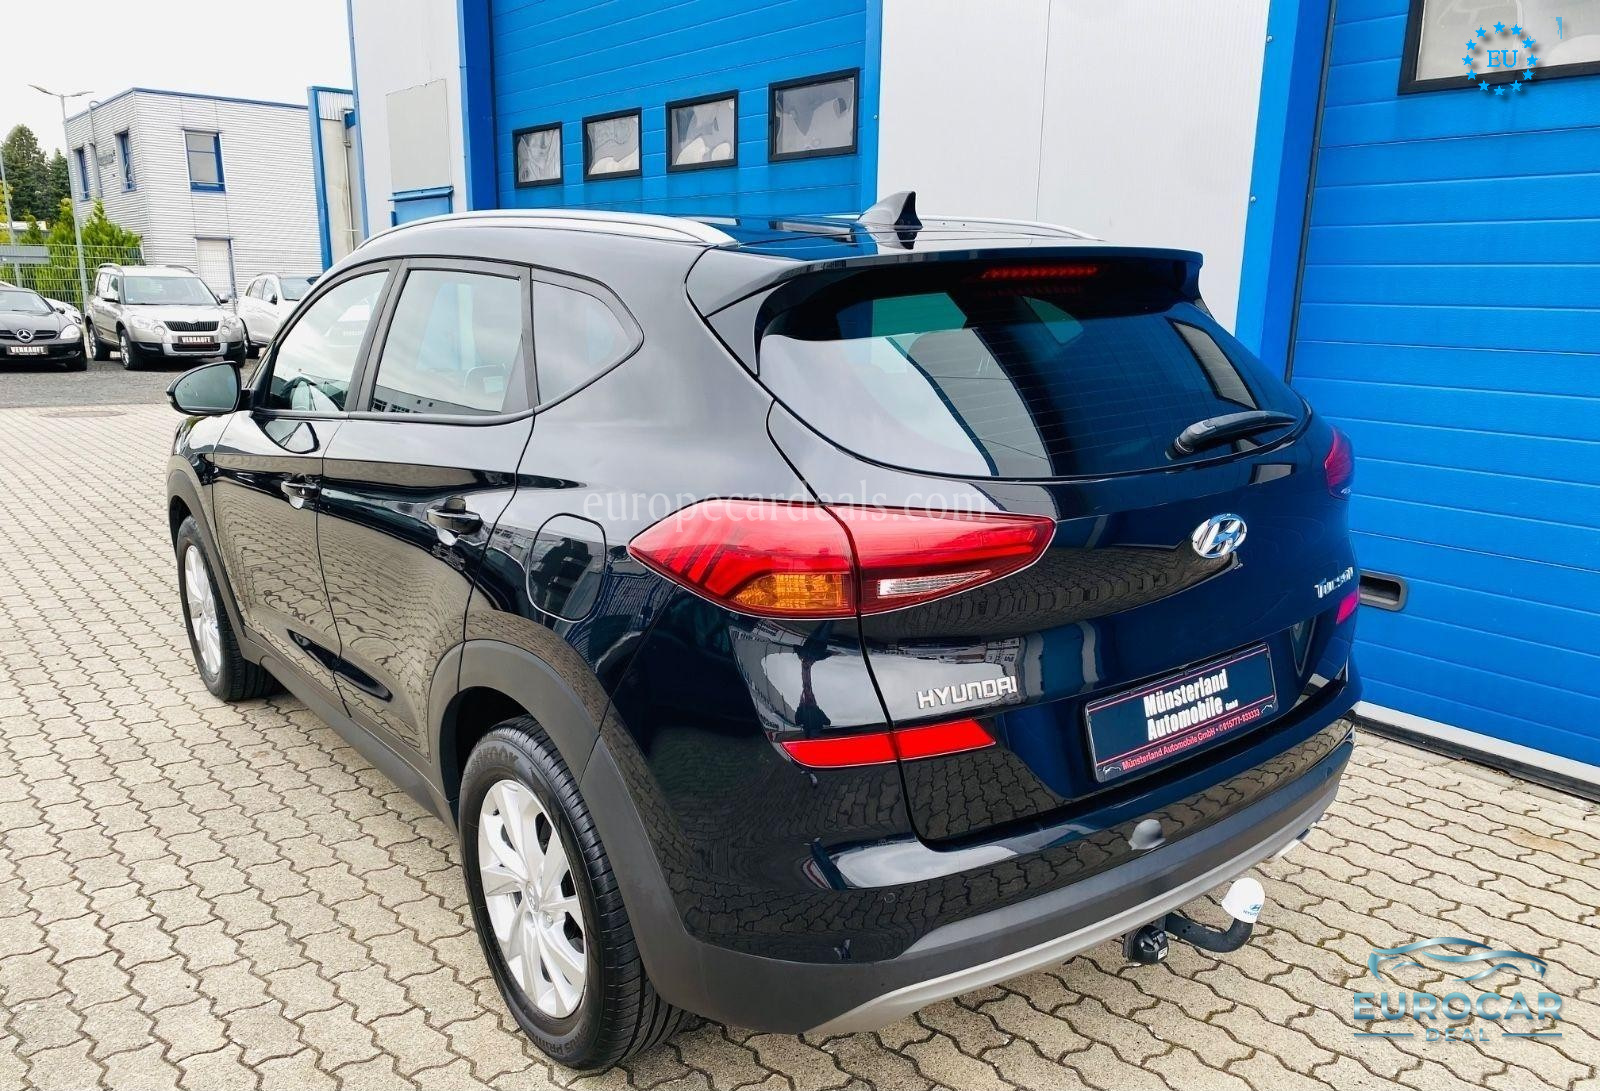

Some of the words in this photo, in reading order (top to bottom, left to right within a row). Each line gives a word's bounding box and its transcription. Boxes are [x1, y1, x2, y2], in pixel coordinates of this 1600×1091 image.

[917, 675, 1018, 709] HYUNDAI
[1143, 669, 1228, 718] Münsterland
[1147, 696, 1223, 742] Automobile
[1122, 747, 1163, 770] Münsterland
[1164, 736, 1198, 756] Automobile
